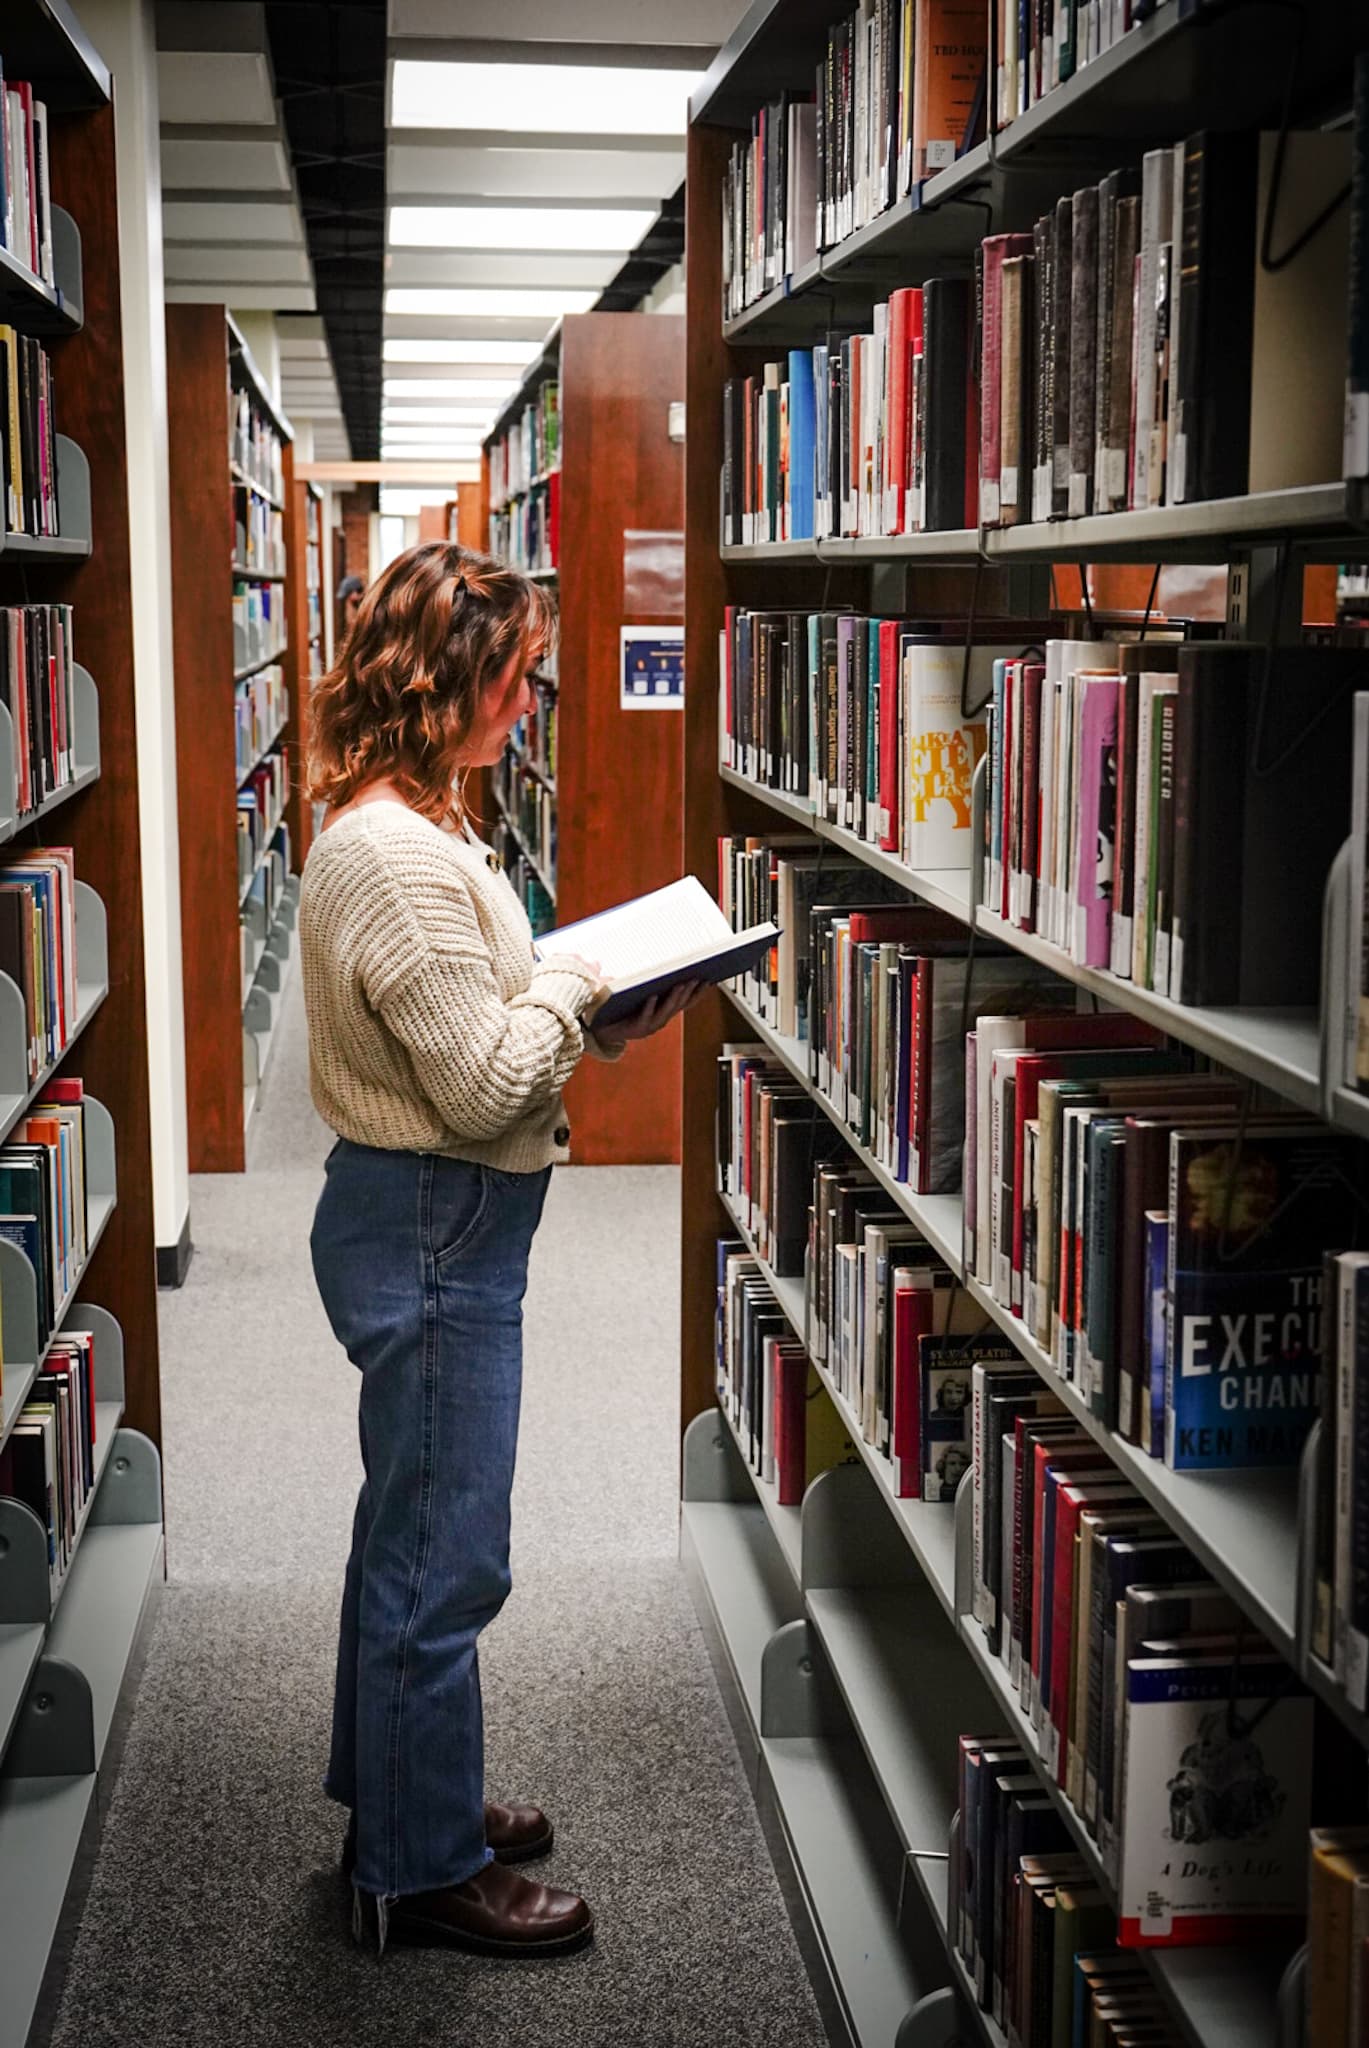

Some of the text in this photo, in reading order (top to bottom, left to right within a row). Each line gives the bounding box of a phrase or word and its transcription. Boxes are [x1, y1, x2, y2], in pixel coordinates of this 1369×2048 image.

[827, 664, 838, 696] Death
[1219, 1375, 1323, 1411] CHAN
[1178, 1422, 1233, 1456] KEN
[1181, 1861, 1234, 1880] Dog's
[1243, 1858, 1283, 1880] Life
